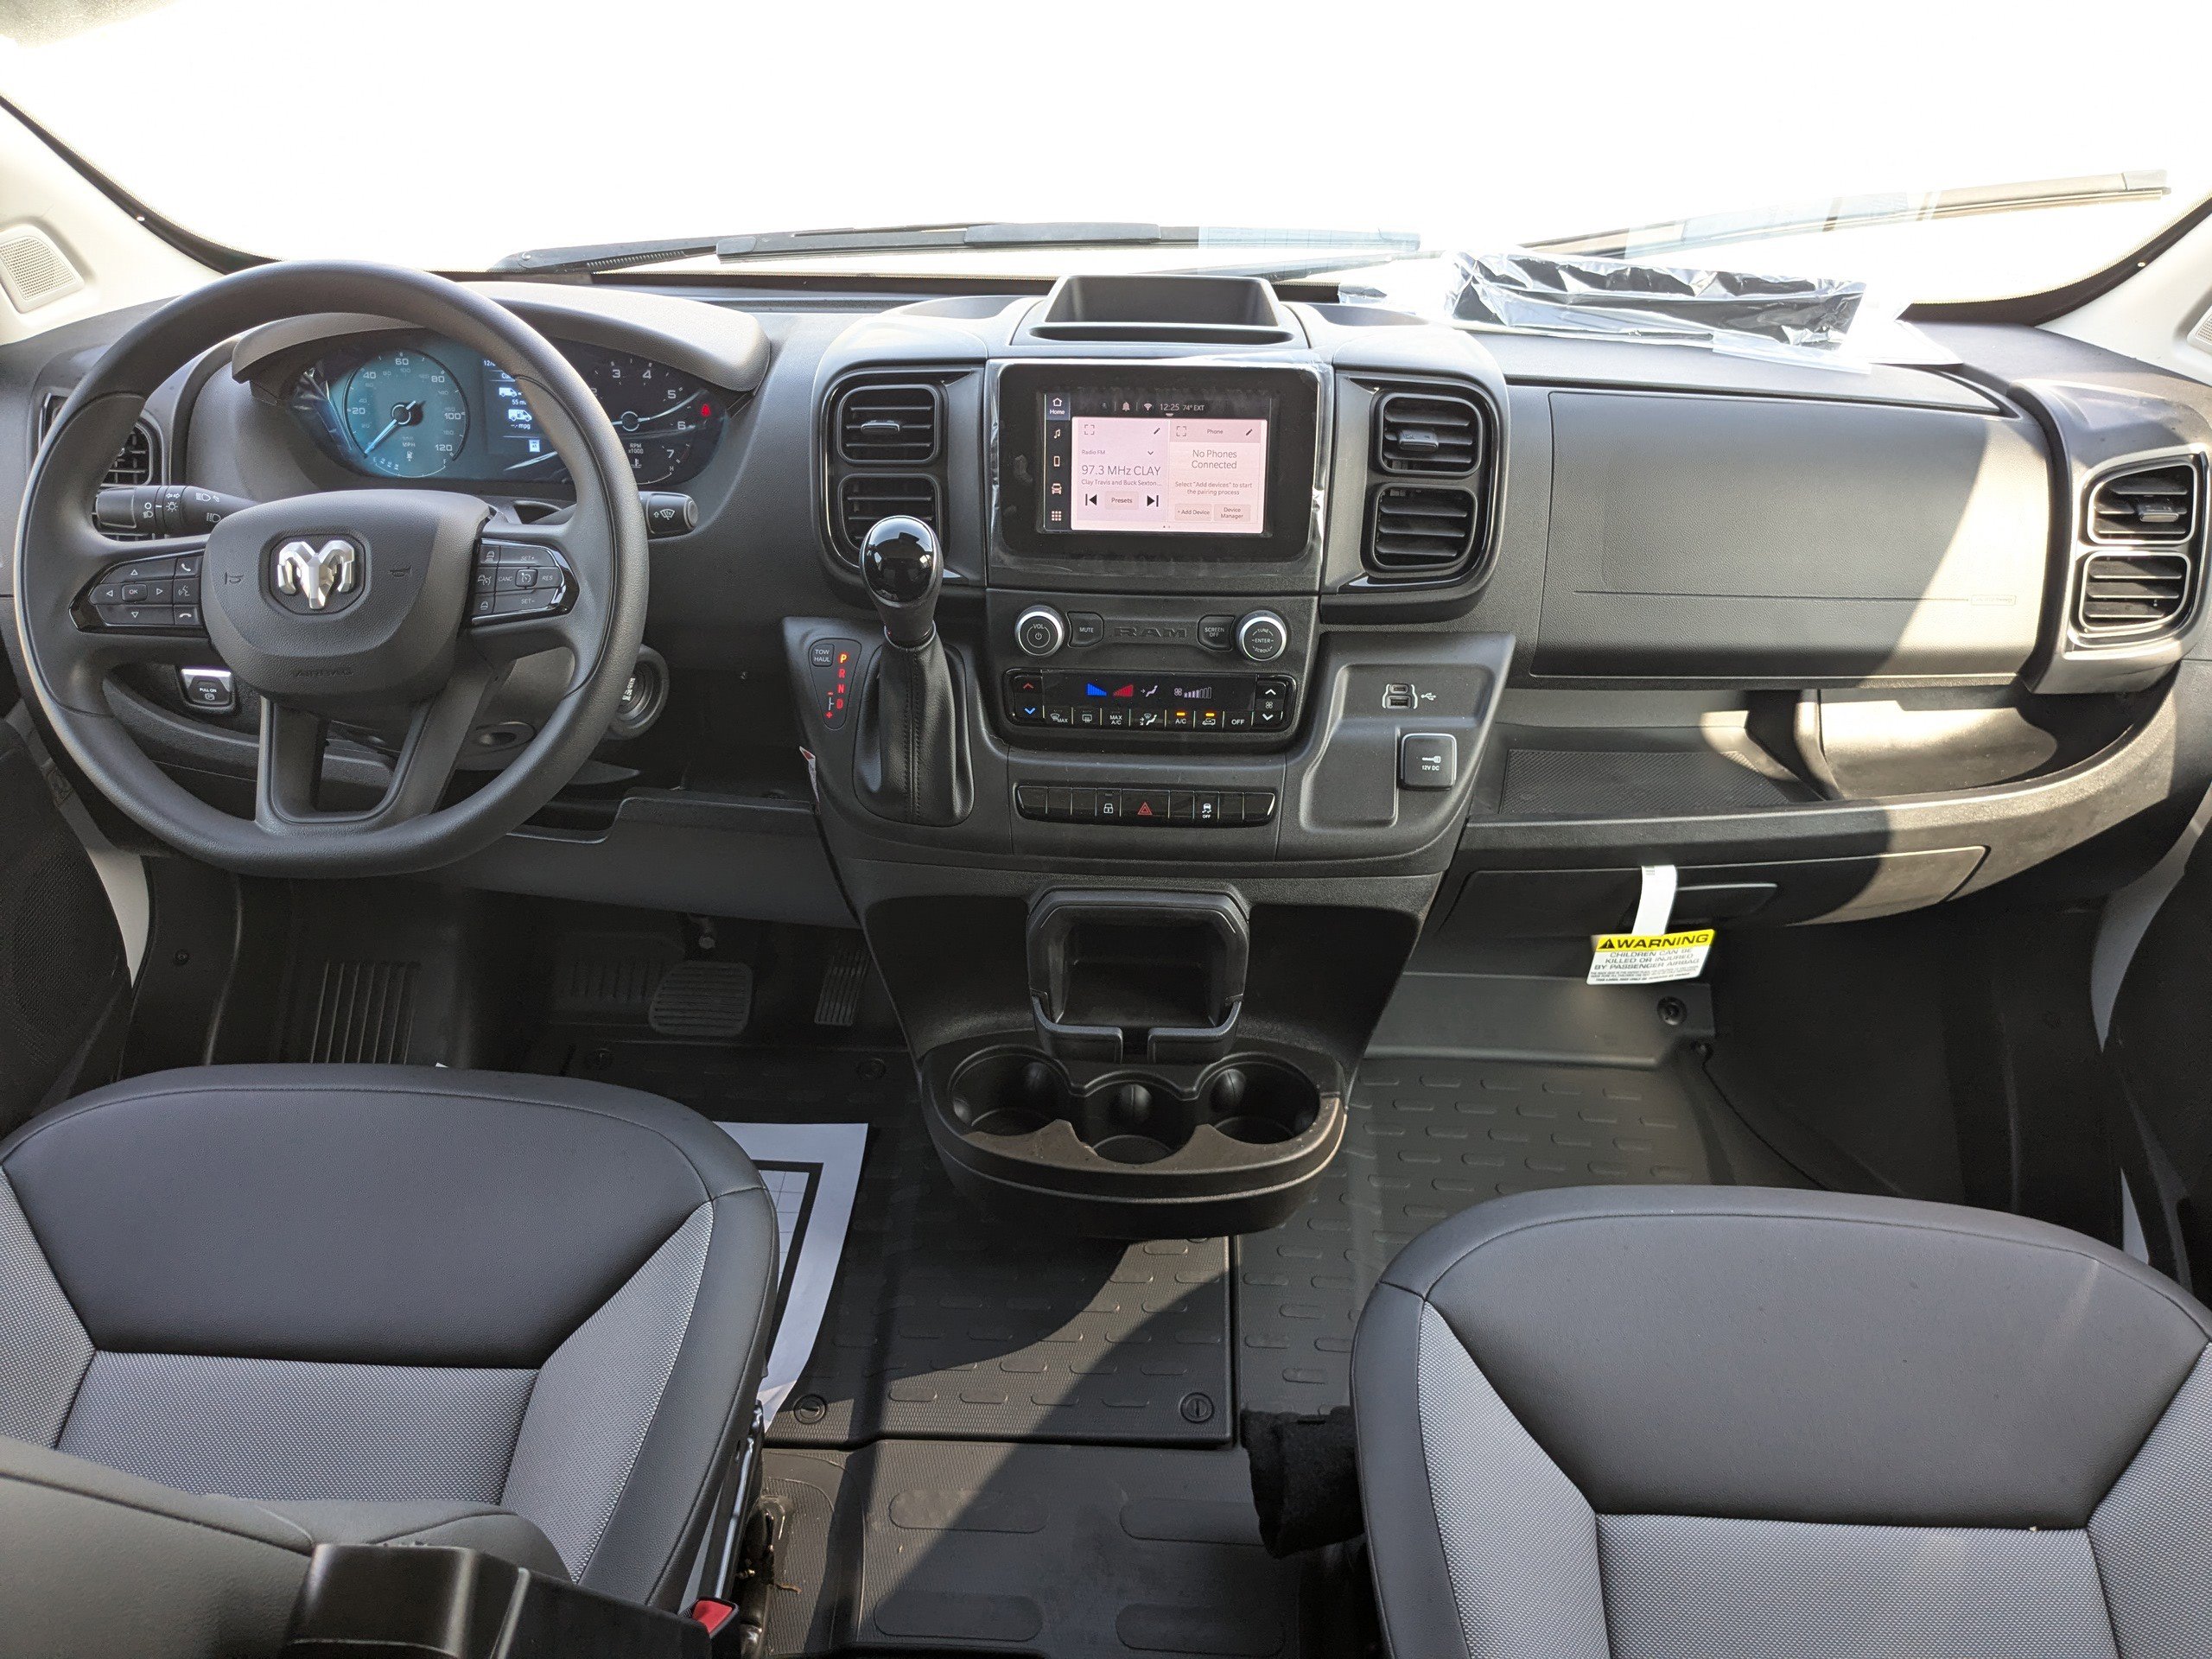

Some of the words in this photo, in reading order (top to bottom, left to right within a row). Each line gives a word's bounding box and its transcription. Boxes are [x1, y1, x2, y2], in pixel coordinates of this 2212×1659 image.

[612, 369, 620, 378] 3
[643, 370, 652, 378] 4
[667, 390, 677, 399] 5
[1160, 403, 1179, 411] 12:25
[677, 421, 686, 430] 6
[666, 449, 675, 458] 7
[1192, 449, 1205, 458] No
[1206, 449, 1237, 458] Phones
[1192, 461, 1237, 469] Connected
[1081, 465, 1104, 475] 97.3
[1107, 466, 1131, 476] MHz
[1134, 466, 1161, 476] CLAY
[1114, 627, 1187, 638] RAM
[840, 654, 847, 664] P
[838, 668, 846, 678] R
[838, 684, 845, 694] N
[836, 698, 843, 709] D
[1617, 934, 1709, 949] WARNING
[1655, 954, 1694, 963] INJURED
[1667, 958, 1700, 967] AIRBAG
